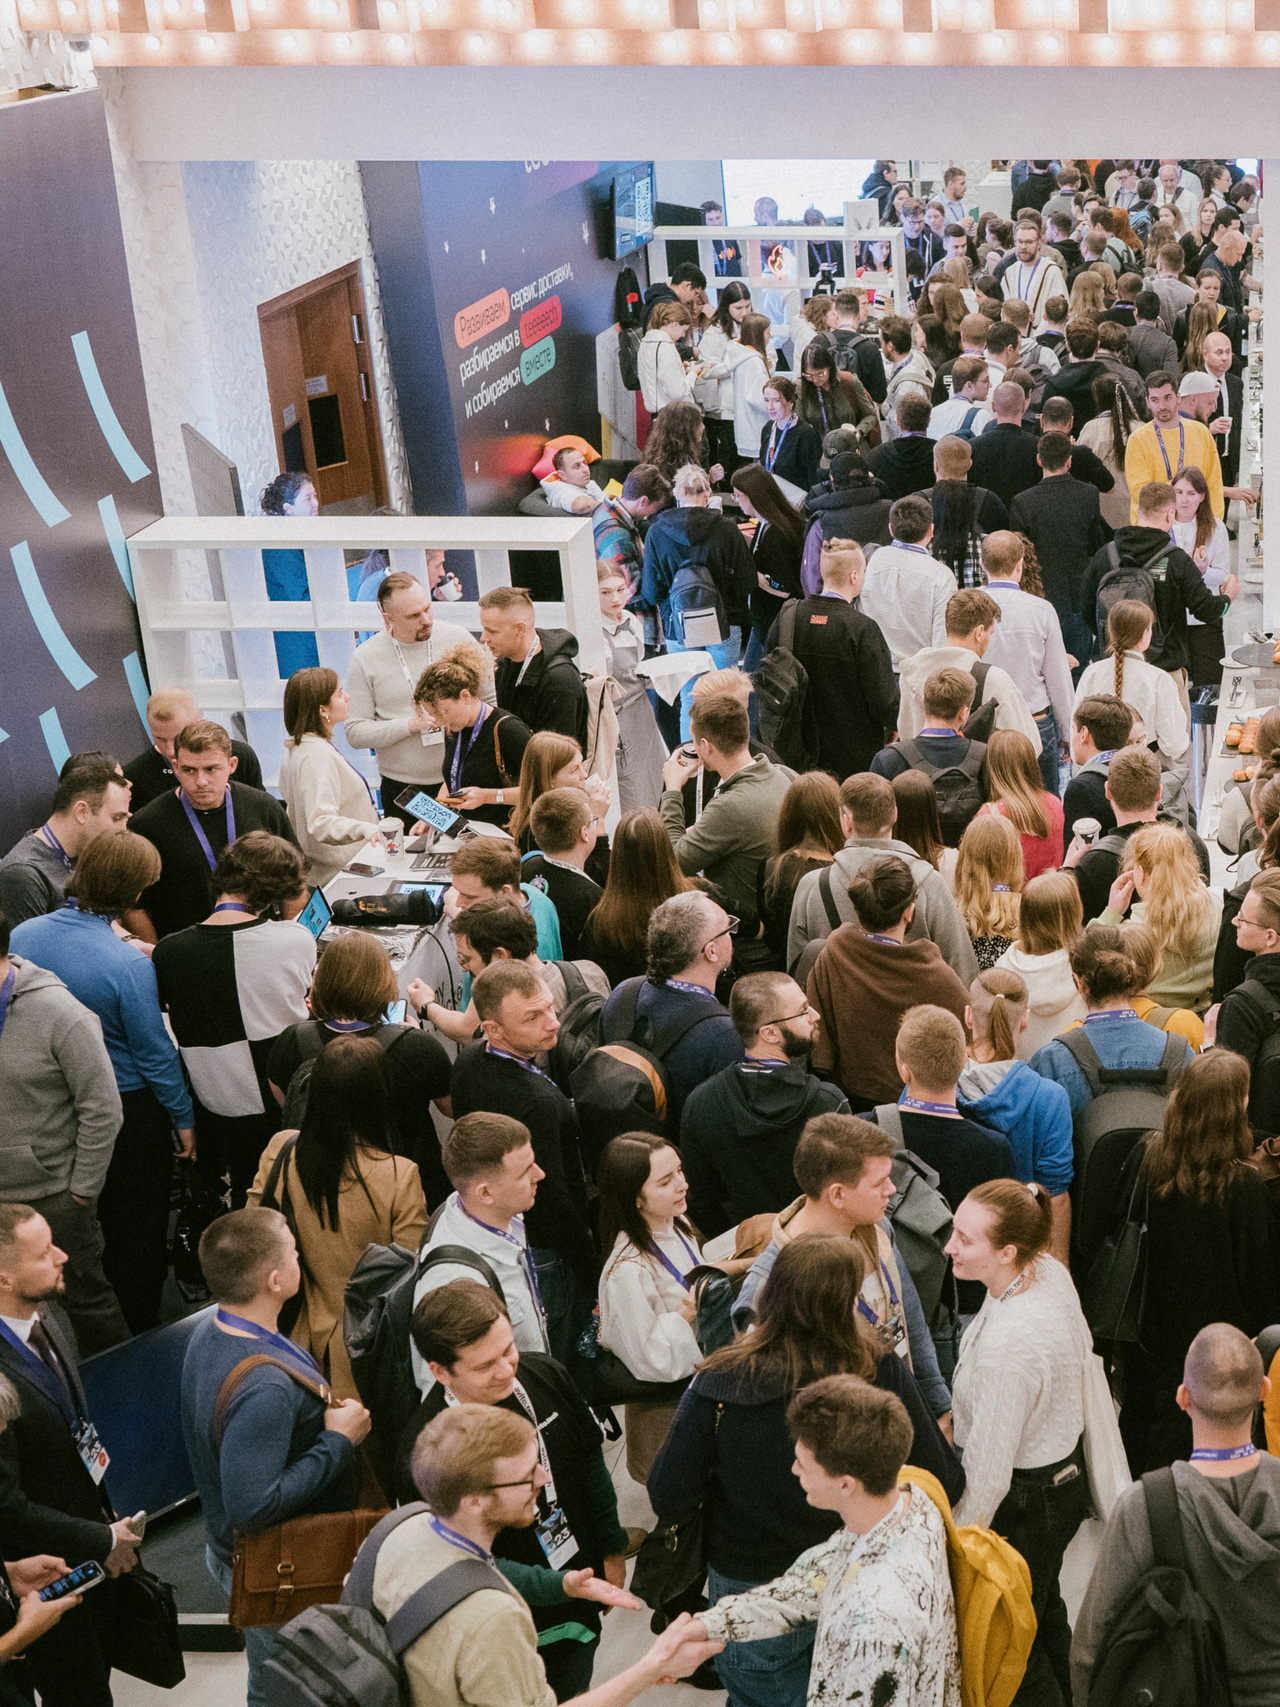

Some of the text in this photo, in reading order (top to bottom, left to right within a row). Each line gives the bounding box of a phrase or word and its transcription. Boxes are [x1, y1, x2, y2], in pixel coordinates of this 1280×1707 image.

[459, 262, 574, 340] Развиваем сервис доставки,
[459, 334, 514, 388] разбираемся
[513, 329, 521, 347] в
[465, 346, 552, 419] и собираемся вместе
